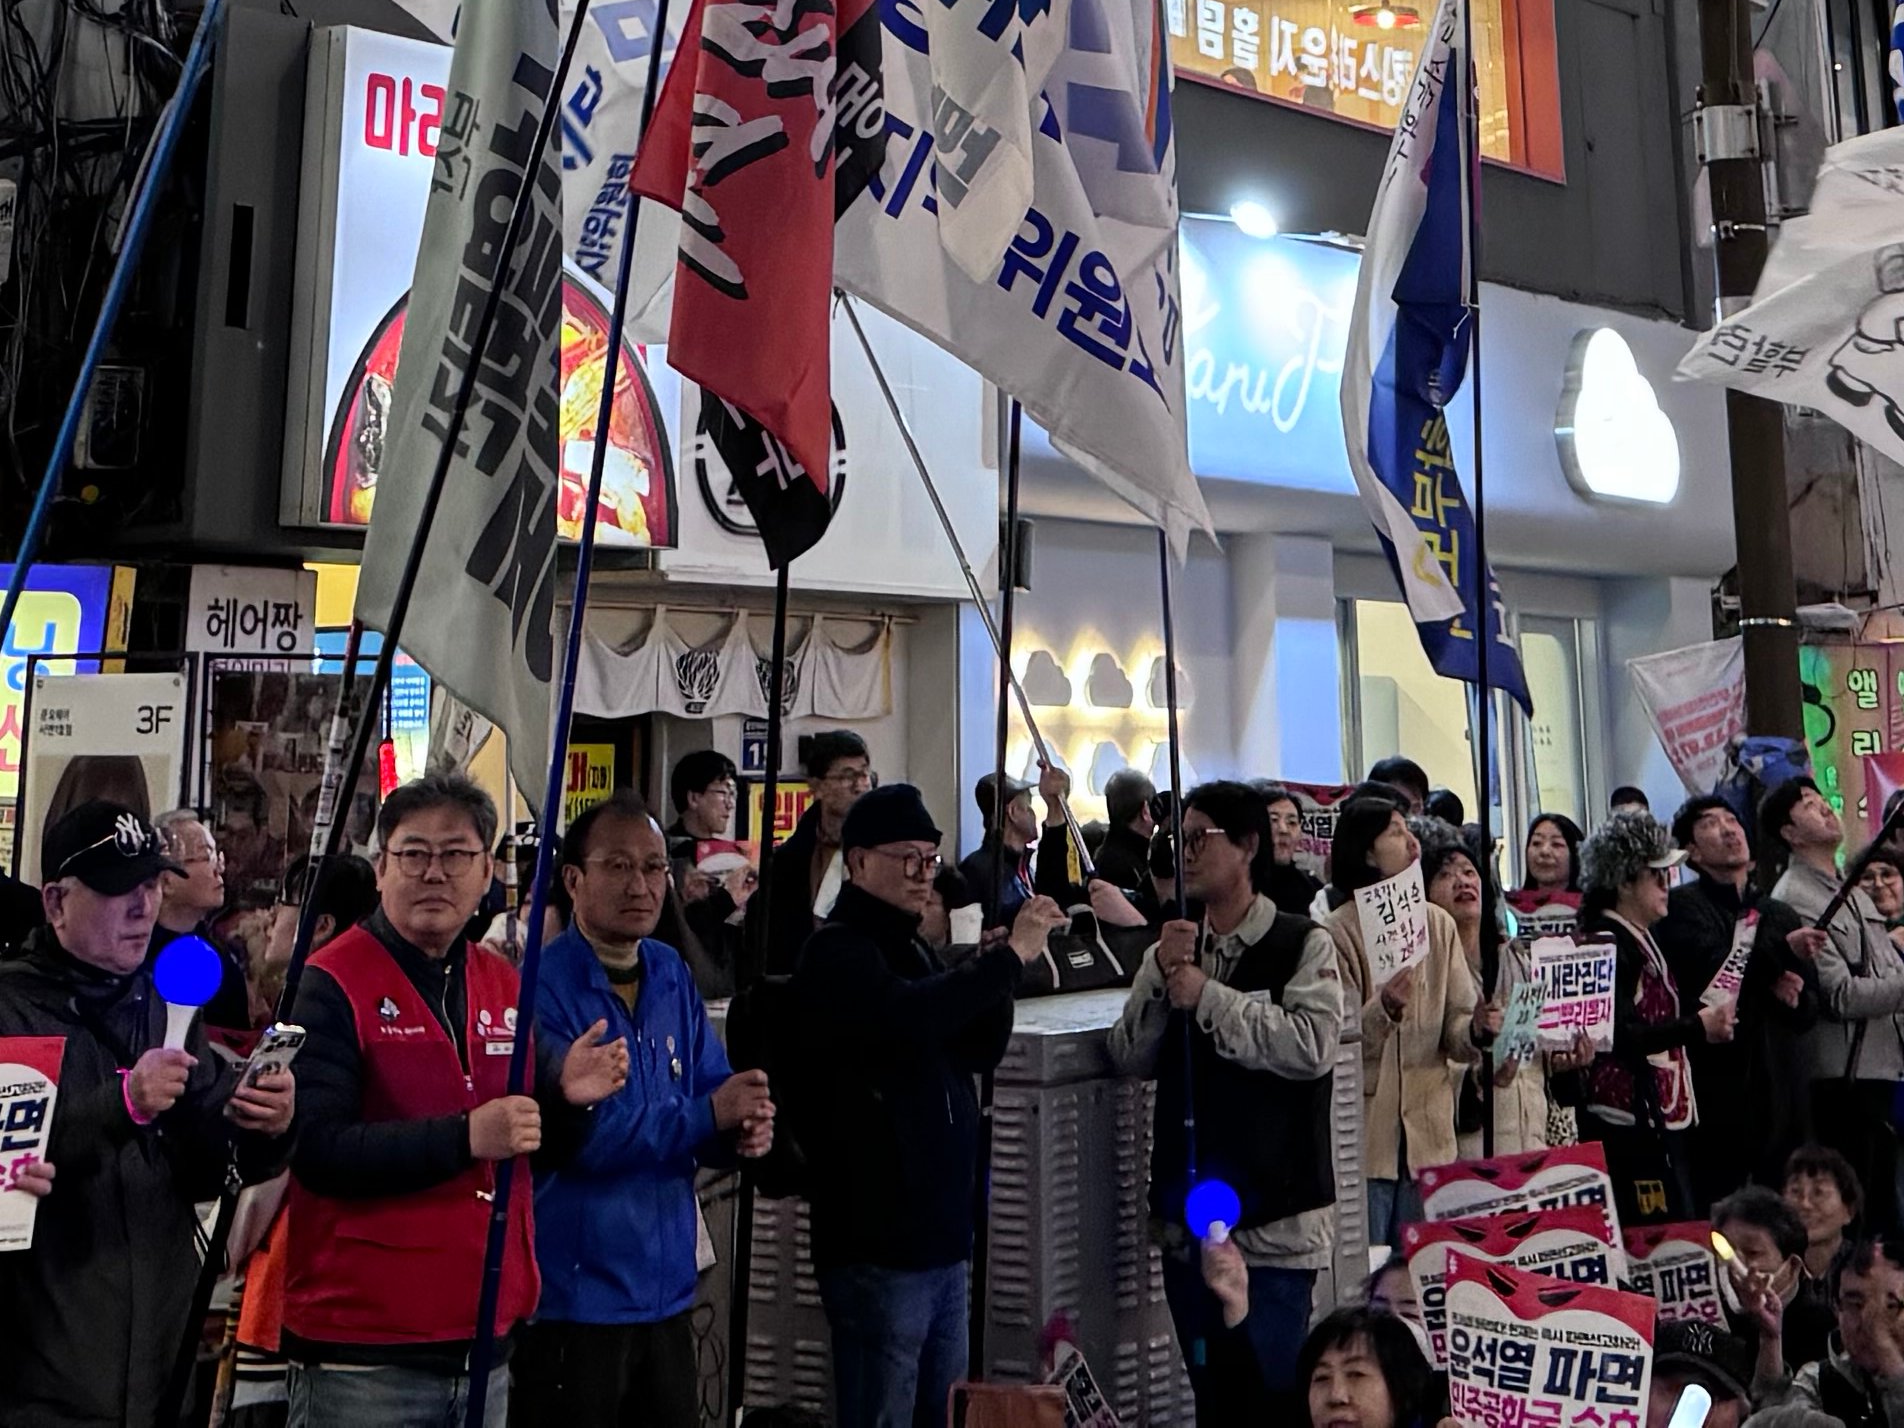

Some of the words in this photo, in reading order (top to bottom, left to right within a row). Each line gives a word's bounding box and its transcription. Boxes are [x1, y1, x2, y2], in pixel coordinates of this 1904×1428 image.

[205, 598, 304, 652] 헤어짱
[135, 705, 175, 735] 3F
[1449, 1327, 1538, 1395] 윤석열
[1542, 1345, 1647, 1406] 파면
